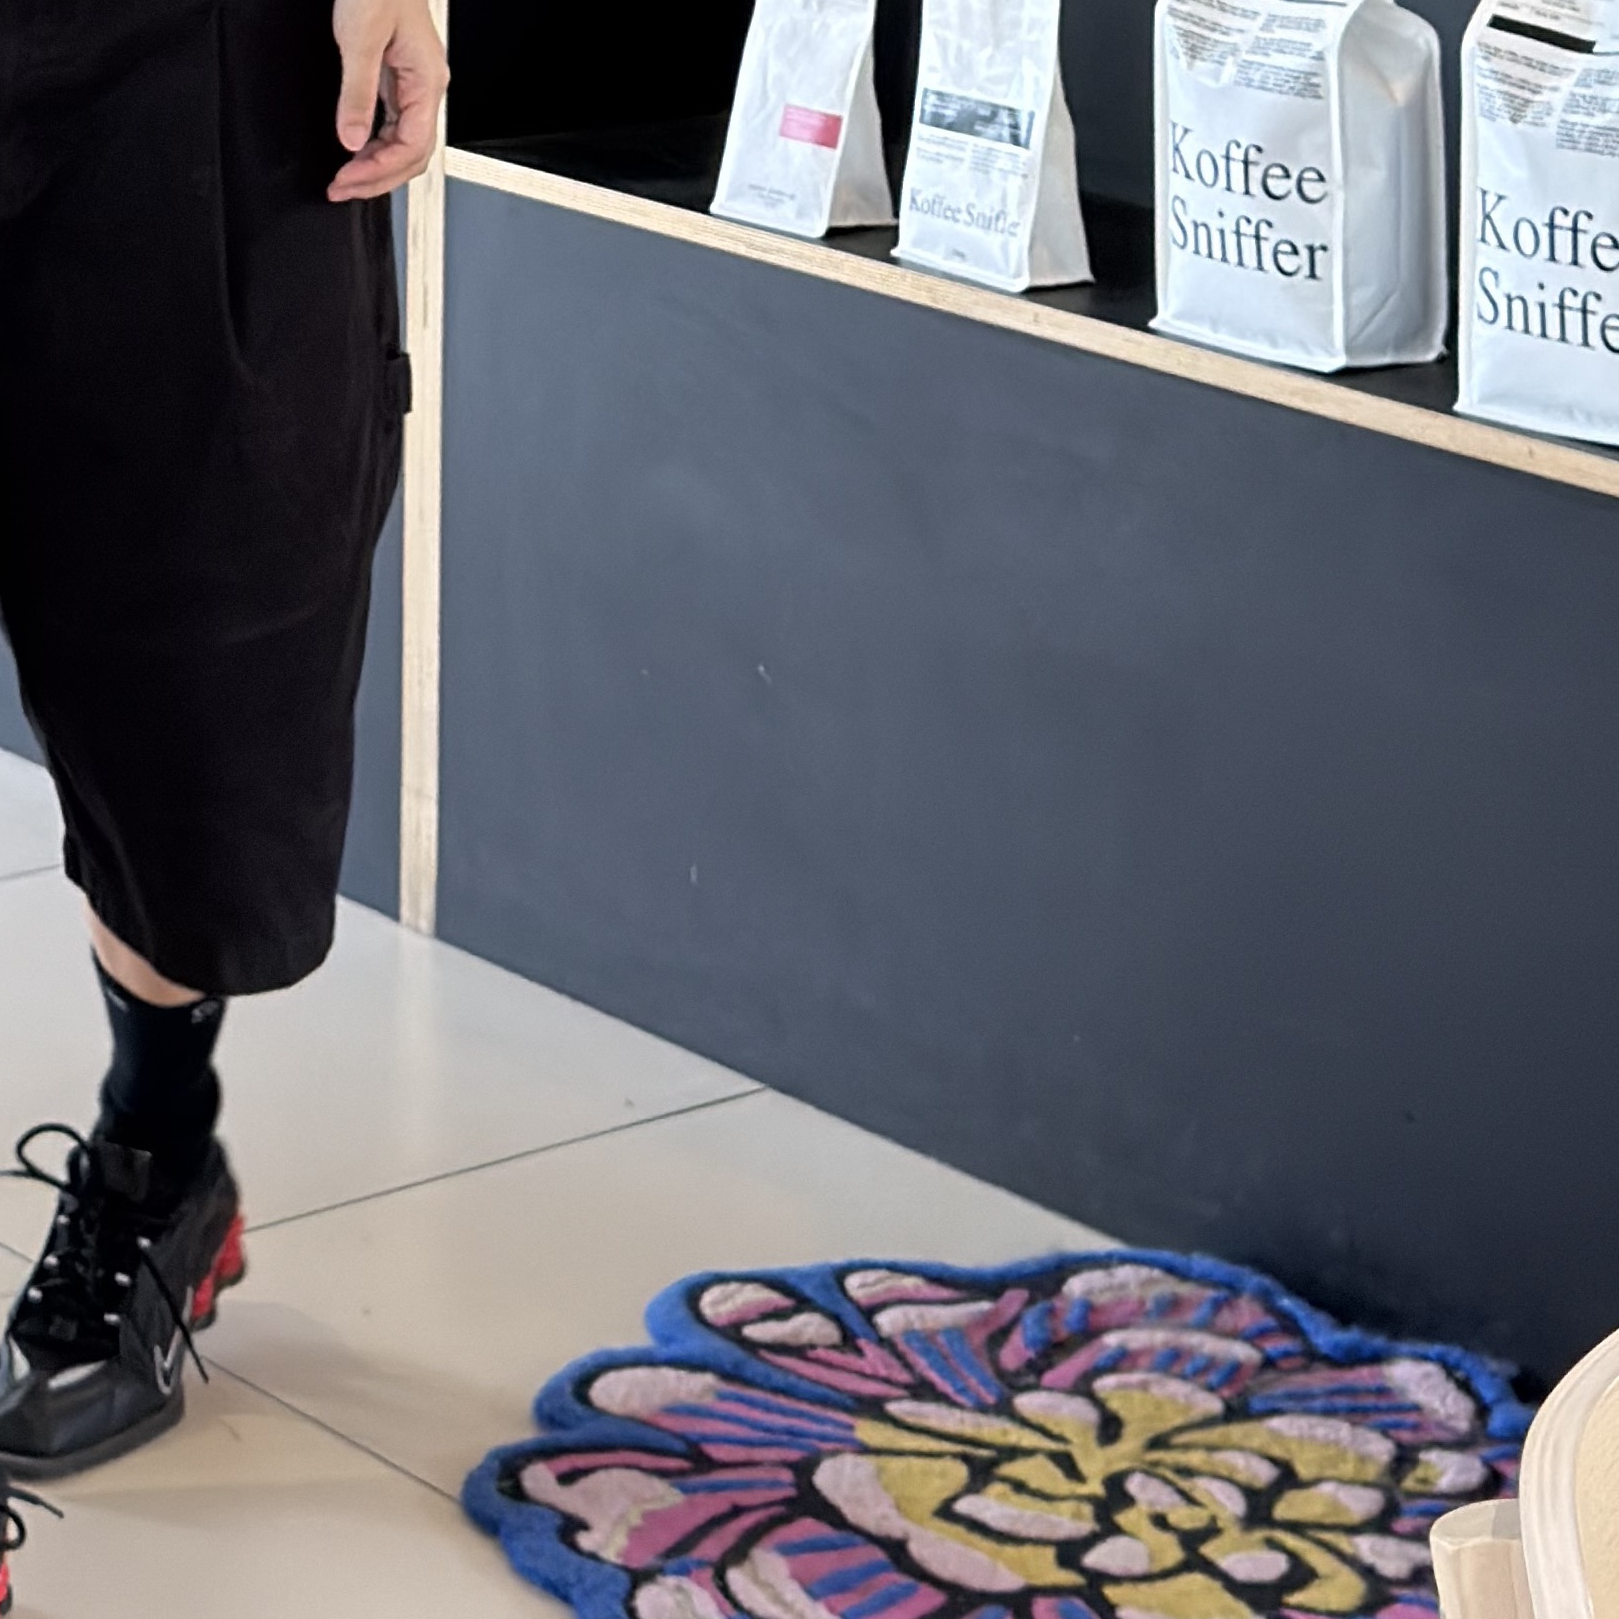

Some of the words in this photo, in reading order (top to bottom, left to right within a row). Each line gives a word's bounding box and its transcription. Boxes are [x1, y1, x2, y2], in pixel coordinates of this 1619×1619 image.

[1170, 120, 1329, 205] Koffee
[909, 188, 962, 224] Koffee
[1170, 194, 1330, 282] Sniffer
